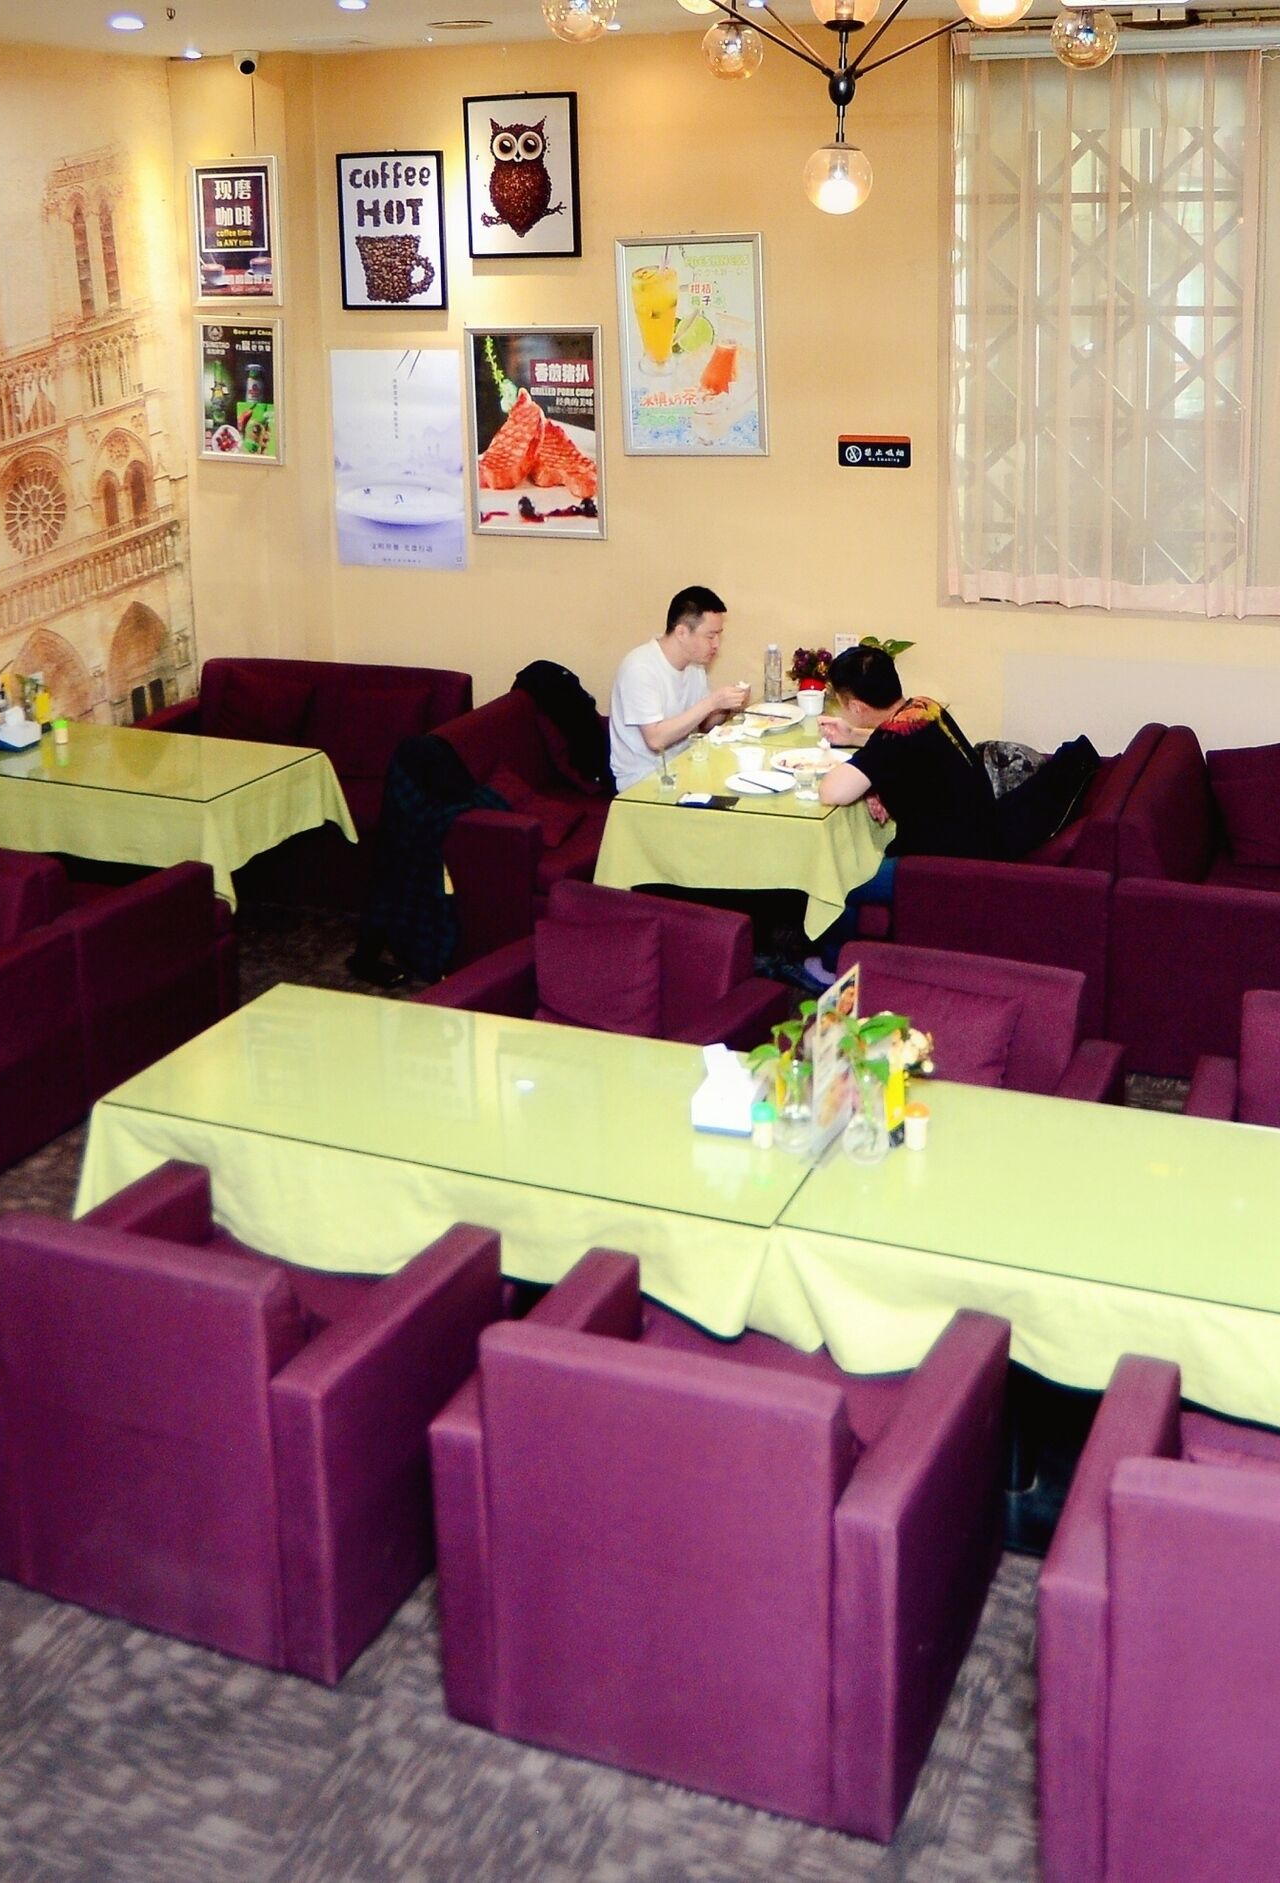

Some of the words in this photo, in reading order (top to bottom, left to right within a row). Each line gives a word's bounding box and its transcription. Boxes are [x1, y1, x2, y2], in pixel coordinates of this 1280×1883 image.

[349, 161, 431, 189] coffee
[214, 179, 252, 200] 现磨
[215, 206, 253, 226] 咖啡
[356, 198, 423, 227] HOT
[216, 229, 237, 237] coffee
[237, 228, 252, 236] time
[223, 239, 238, 247] ANY
[239, 239, 254, 247] time
[534, 363, 590, 383] 香煎猪扒
[557, 388, 575, 396] PORK
[576, 388, 594, 397] CHOP
